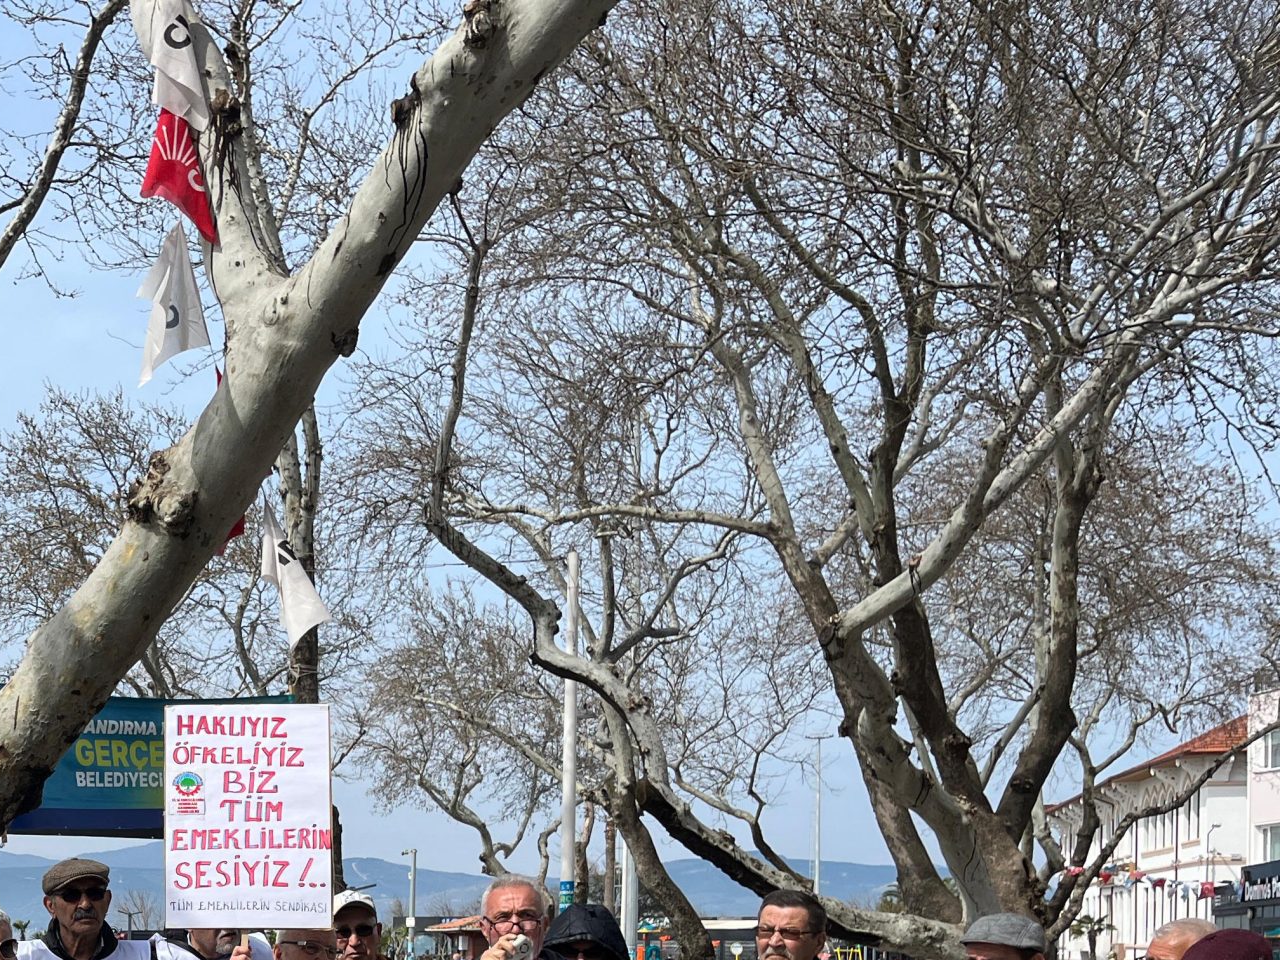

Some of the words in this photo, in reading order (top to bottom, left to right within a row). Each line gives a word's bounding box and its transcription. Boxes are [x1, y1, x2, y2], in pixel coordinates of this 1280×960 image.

[177, 714, 288, 738] HAKLIYIZ
[173, 741, 305, 767] ÖFKELİYİZ
[223, 765, 278, 794] BİZ
[220, 795, 284, 822] TÜM
[171, 824, 333, 851] EMEKLİLERİN
[170, 900, 193, 911] TÜM
[198, 900, 270, 912] EMEKLİLERİN
[274, 900, 328, 914] SENDİKASI
